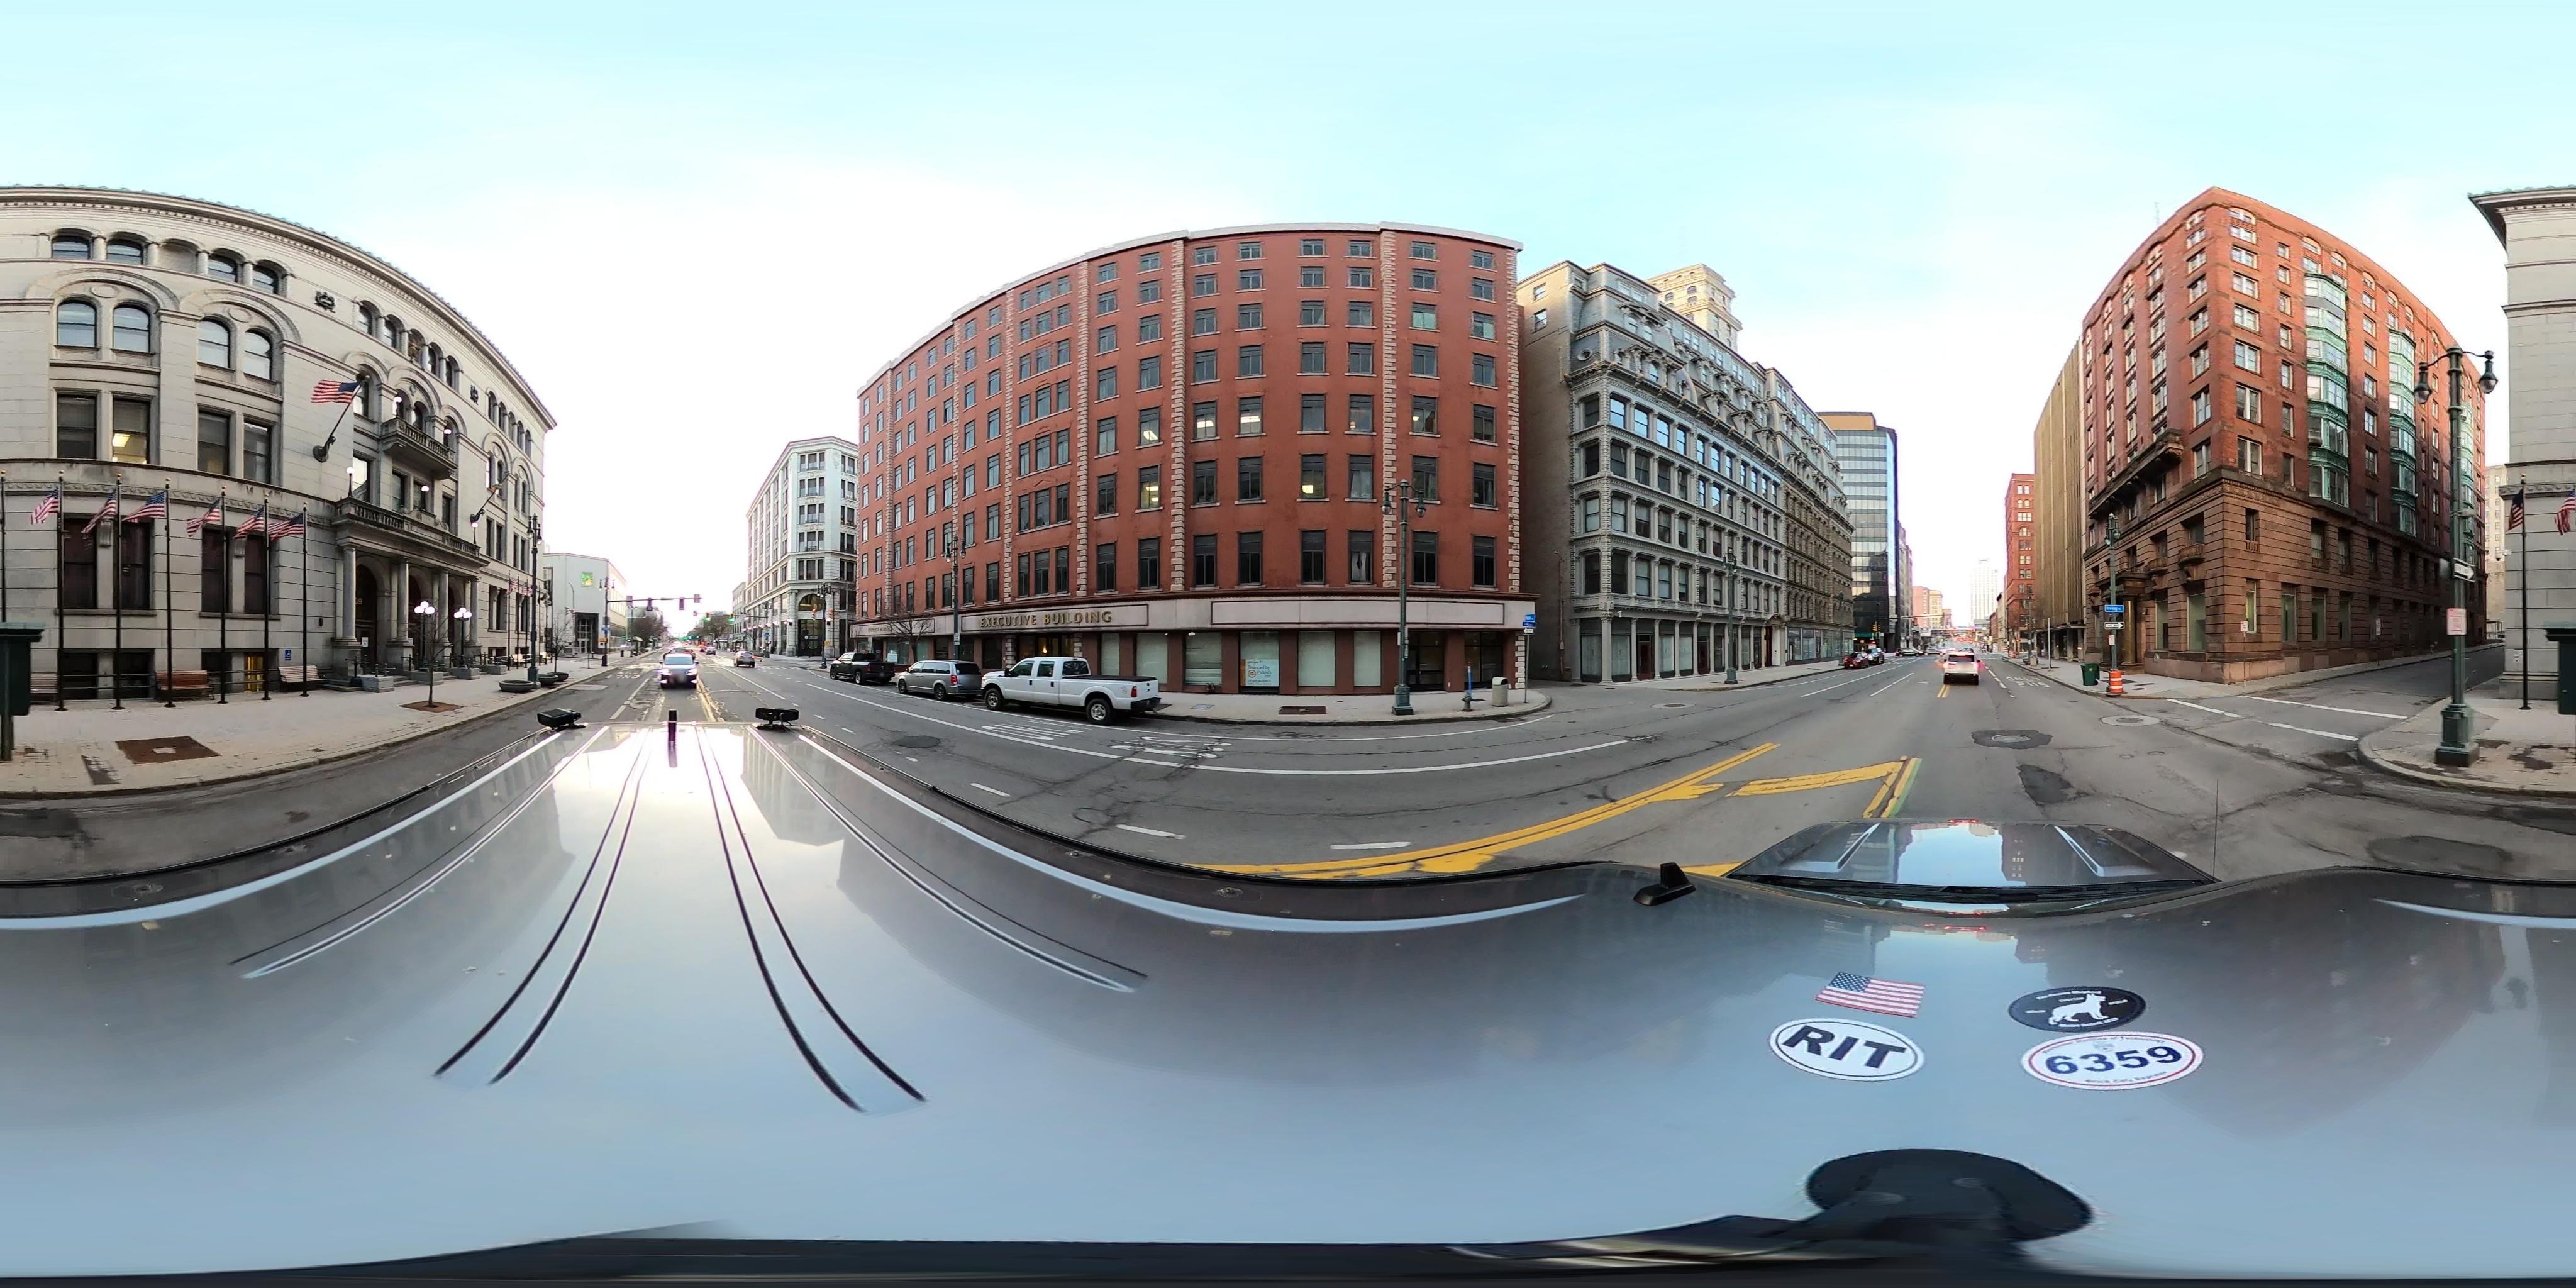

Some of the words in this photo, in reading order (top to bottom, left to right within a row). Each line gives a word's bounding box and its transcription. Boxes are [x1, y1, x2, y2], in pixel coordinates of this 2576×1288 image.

[980, 614, 1037, 628] EXECUTIVE
[1043, 611, 1112, 625] BUILDING
[1782, 1025, 1907, 1069] RIT
[2045, 1045, 2182, 1074] 6359
